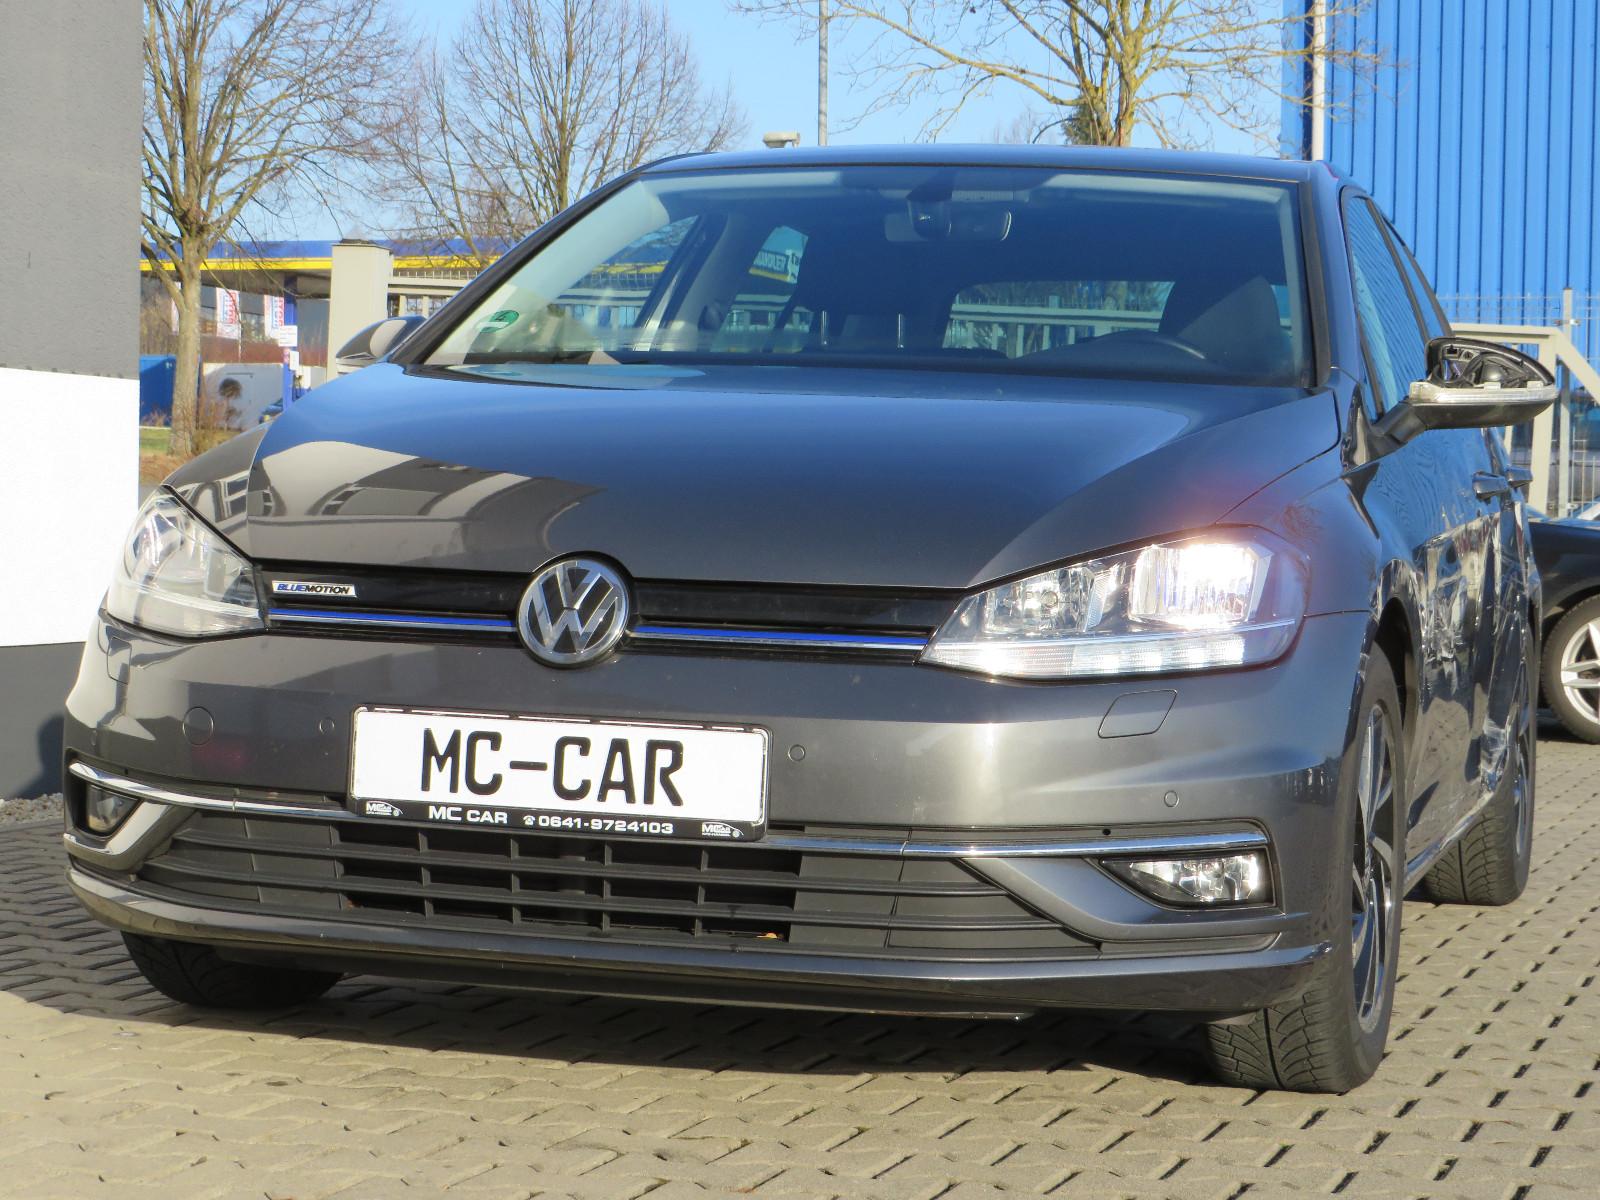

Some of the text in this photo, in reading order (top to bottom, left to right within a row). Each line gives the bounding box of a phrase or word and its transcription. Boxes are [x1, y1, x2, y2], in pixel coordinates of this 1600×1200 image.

[277, 583, 350, 594] BLUEMOTION
[421, 727, 684, 806] MC-CAR
[428, 805, 508, 824] MC CAR
[538, 815, 674, 835] 0641-9724103
